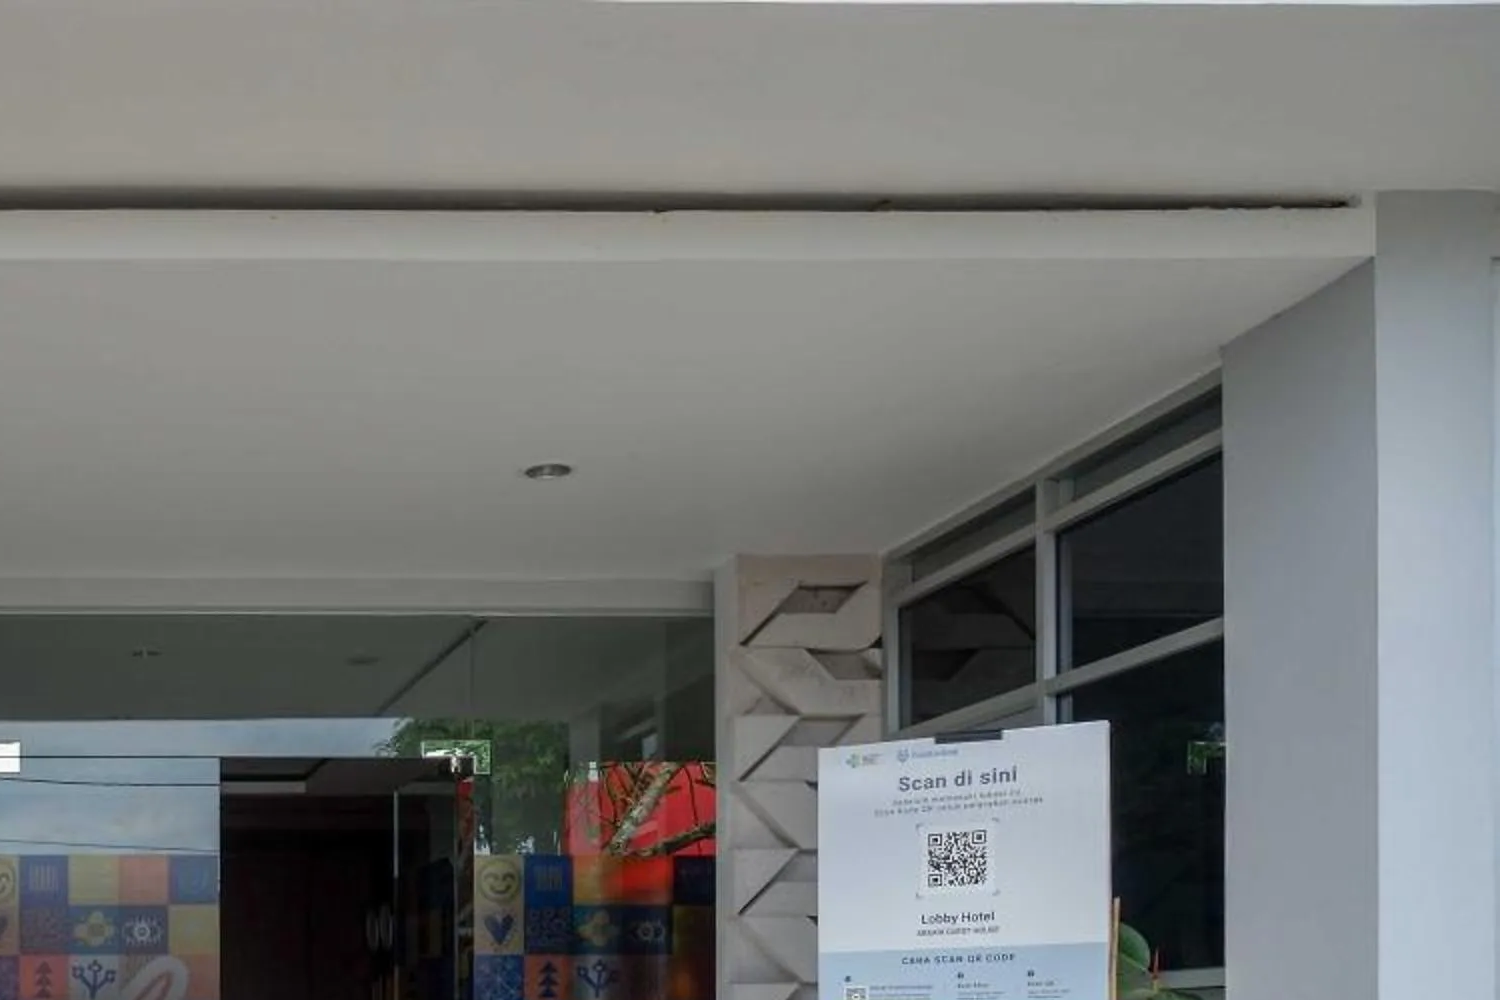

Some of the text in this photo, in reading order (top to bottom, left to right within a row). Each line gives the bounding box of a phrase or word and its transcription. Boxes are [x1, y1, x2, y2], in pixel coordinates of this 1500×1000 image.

[899, 765, 1018, 792] Scan di sini
[921, 911, 995, 925] Lobby Hotel
[934, 955, 963, 963] SCAN
[985, 952, 1015, 963] CODE
